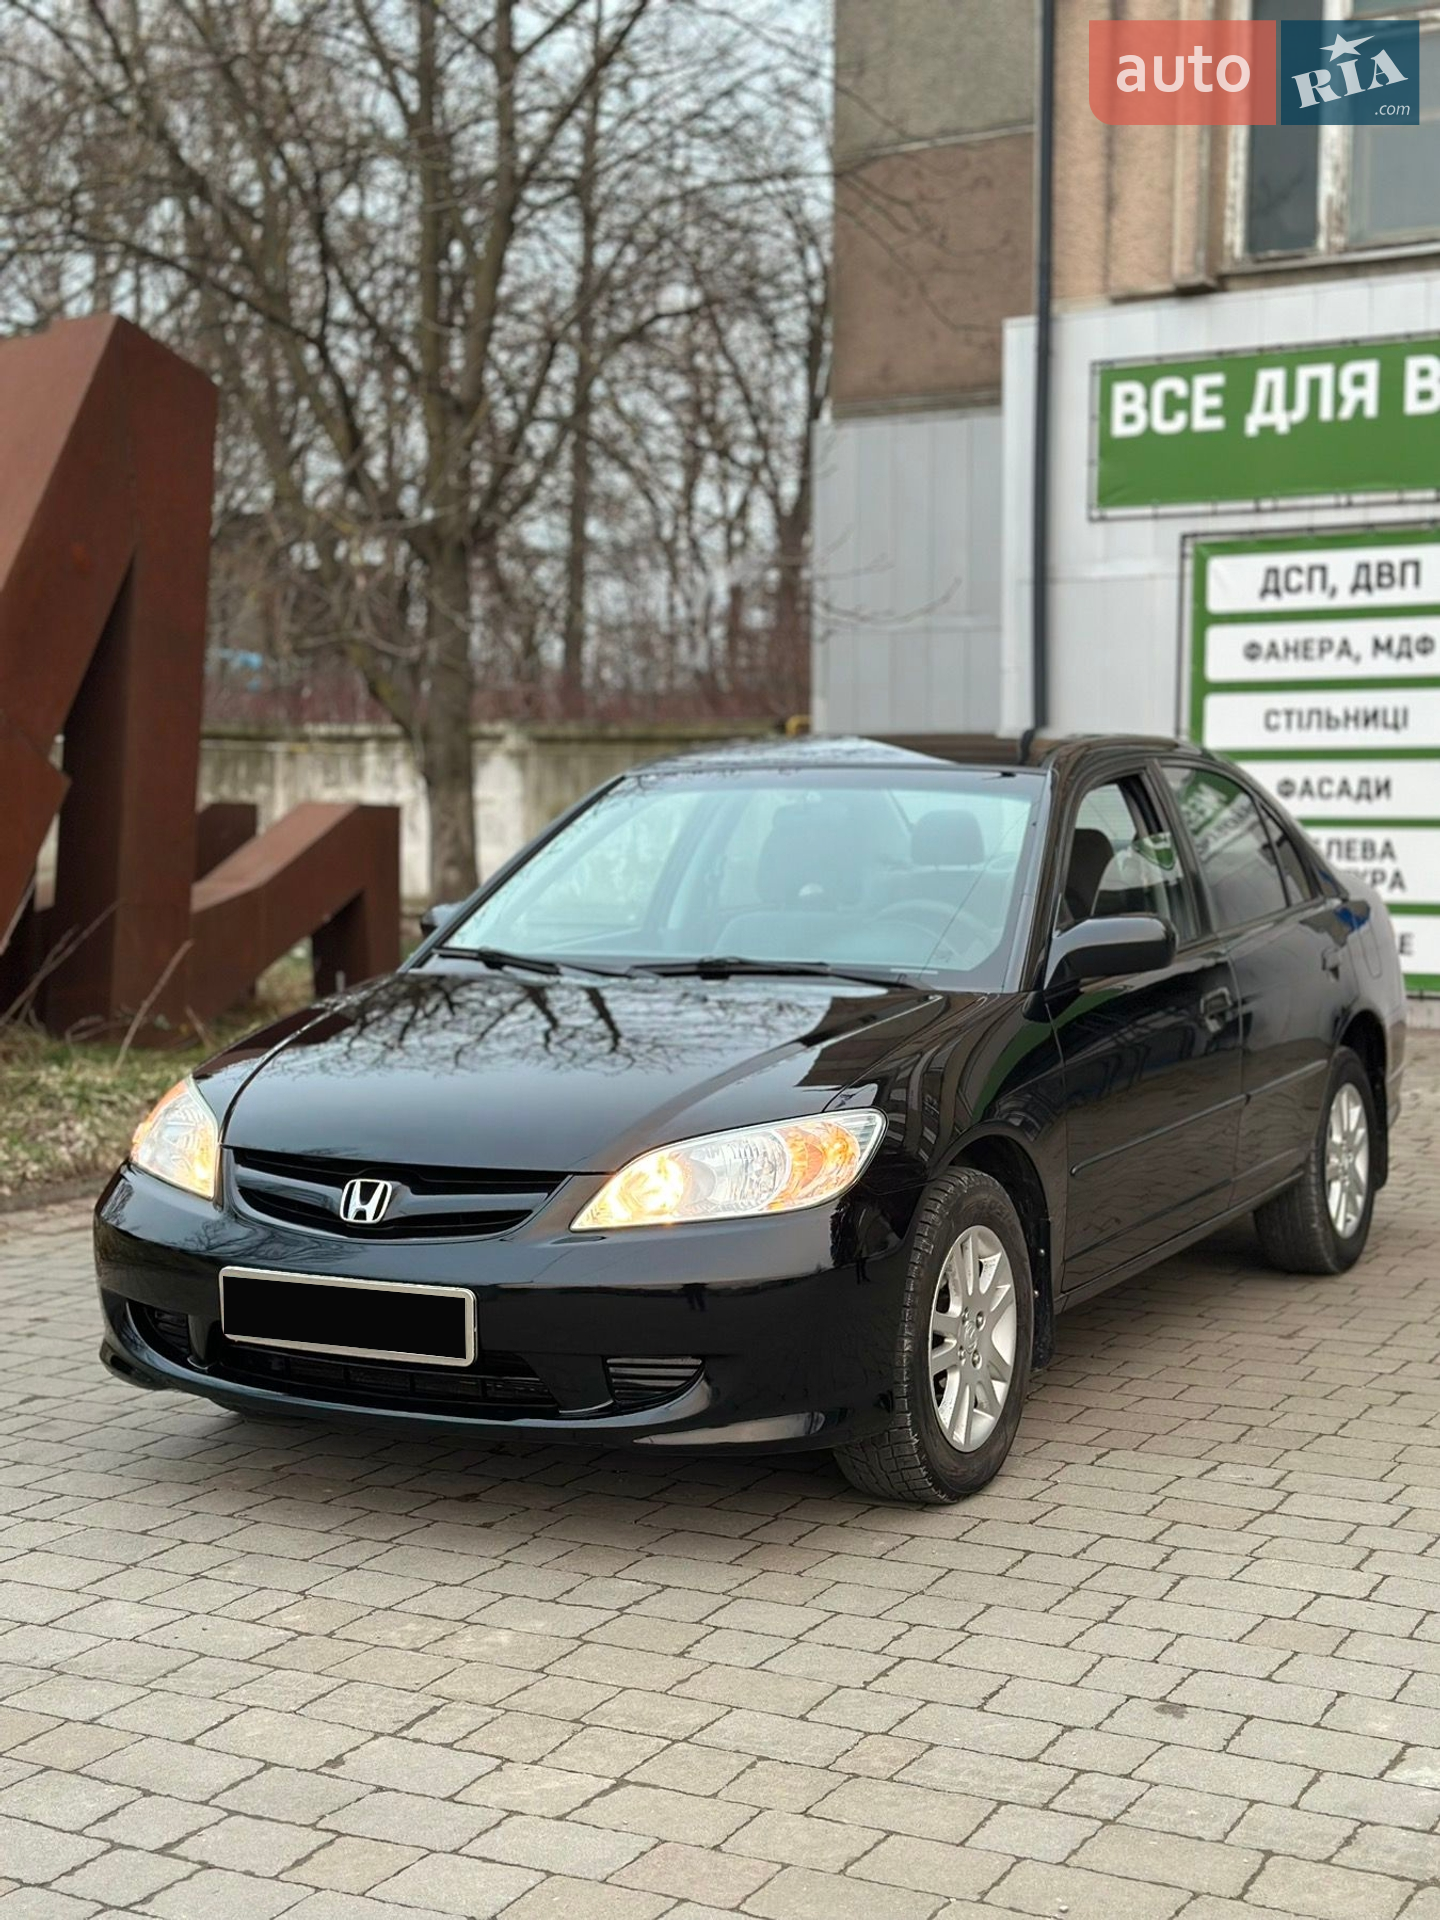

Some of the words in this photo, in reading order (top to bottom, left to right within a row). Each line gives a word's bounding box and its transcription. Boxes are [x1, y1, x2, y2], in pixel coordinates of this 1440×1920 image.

[1111, 372, 1226, 438] ВСЕ
[1244, 358, 1380, 437] ДЛЯ
[1259, 563, 1337, 600] ДСП,
[1349, 559, 1421, 595] ДВП
[1243, 635, 1361, 664] ФАНЕРА,
[1371, 633, 1436, 660] МДФ
[1263, 706, 1410, 732] СТІЛЬНИЦІ
[1276, 776, 1393, 803] ФАСАДИ
[1313, 837, 1397, 862] ЛЕВА
[1356, 869, 1407, 893] РА
